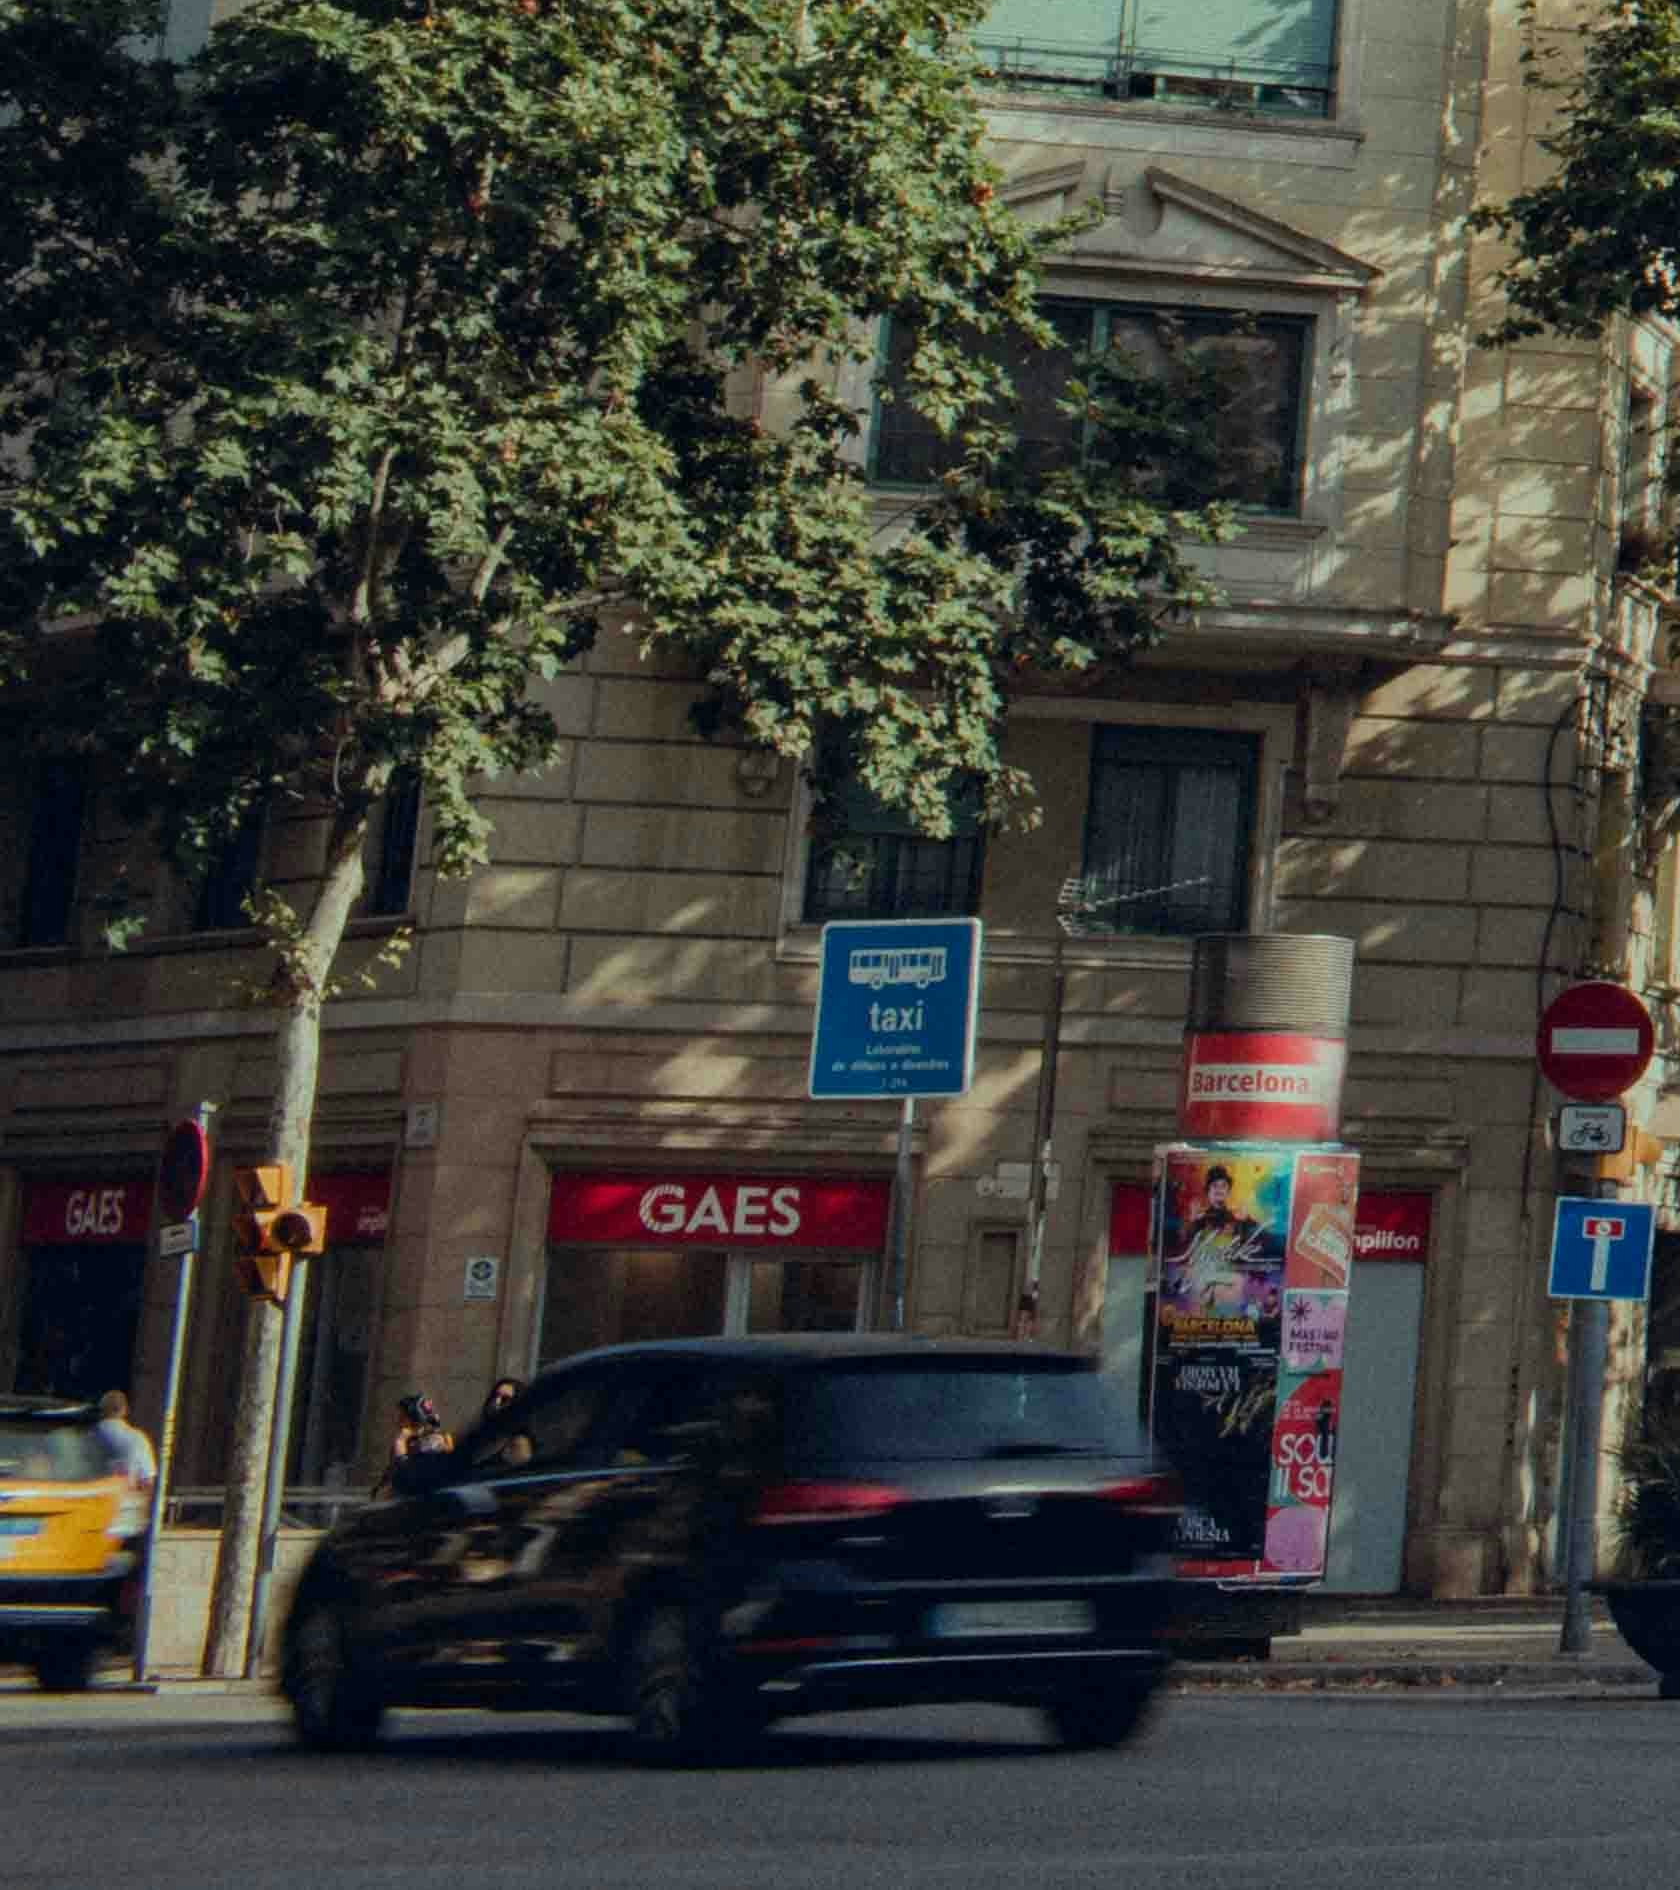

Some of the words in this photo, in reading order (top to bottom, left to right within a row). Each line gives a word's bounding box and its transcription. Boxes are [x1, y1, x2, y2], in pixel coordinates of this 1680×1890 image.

[869, 1000, 924, 1033] taxi
[1191, 1070, 1311, 1094] Barcelona
[65, 1190, 127, 1235] GAES
[639, 1183, 801, 1236] GAES
[1172, 1317, 1256, 1336] BARCELONA
